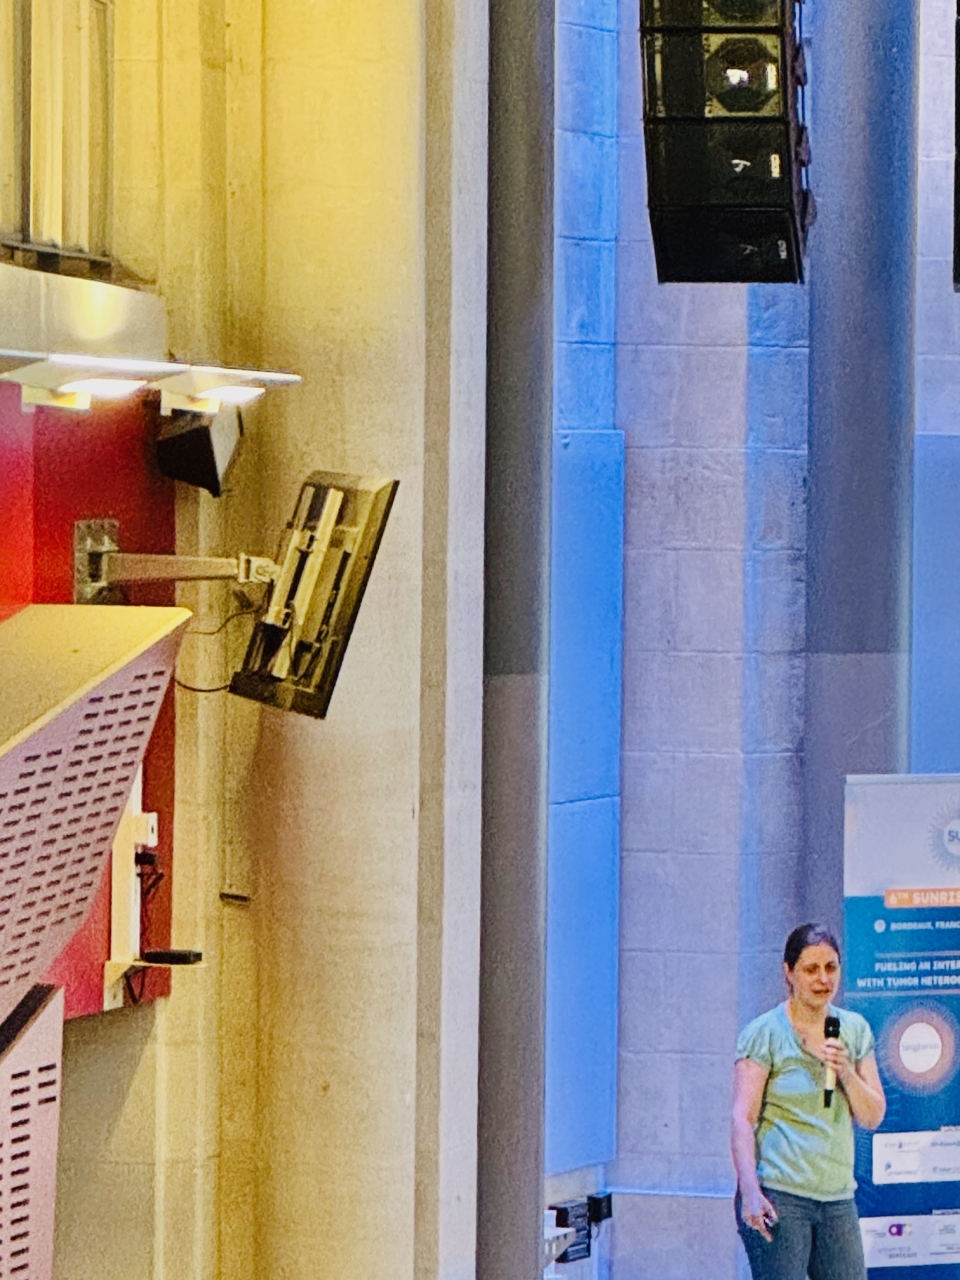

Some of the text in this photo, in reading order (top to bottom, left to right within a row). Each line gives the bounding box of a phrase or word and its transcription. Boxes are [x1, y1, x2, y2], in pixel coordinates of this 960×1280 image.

[889, 892, 908, 905] 6TH
[874, 962, 916, 972] FUELING
[918, 961, 931, 970] AN
[856, 977, 885, 988] WITH
[886, 976, 919, 987] TUMOR
